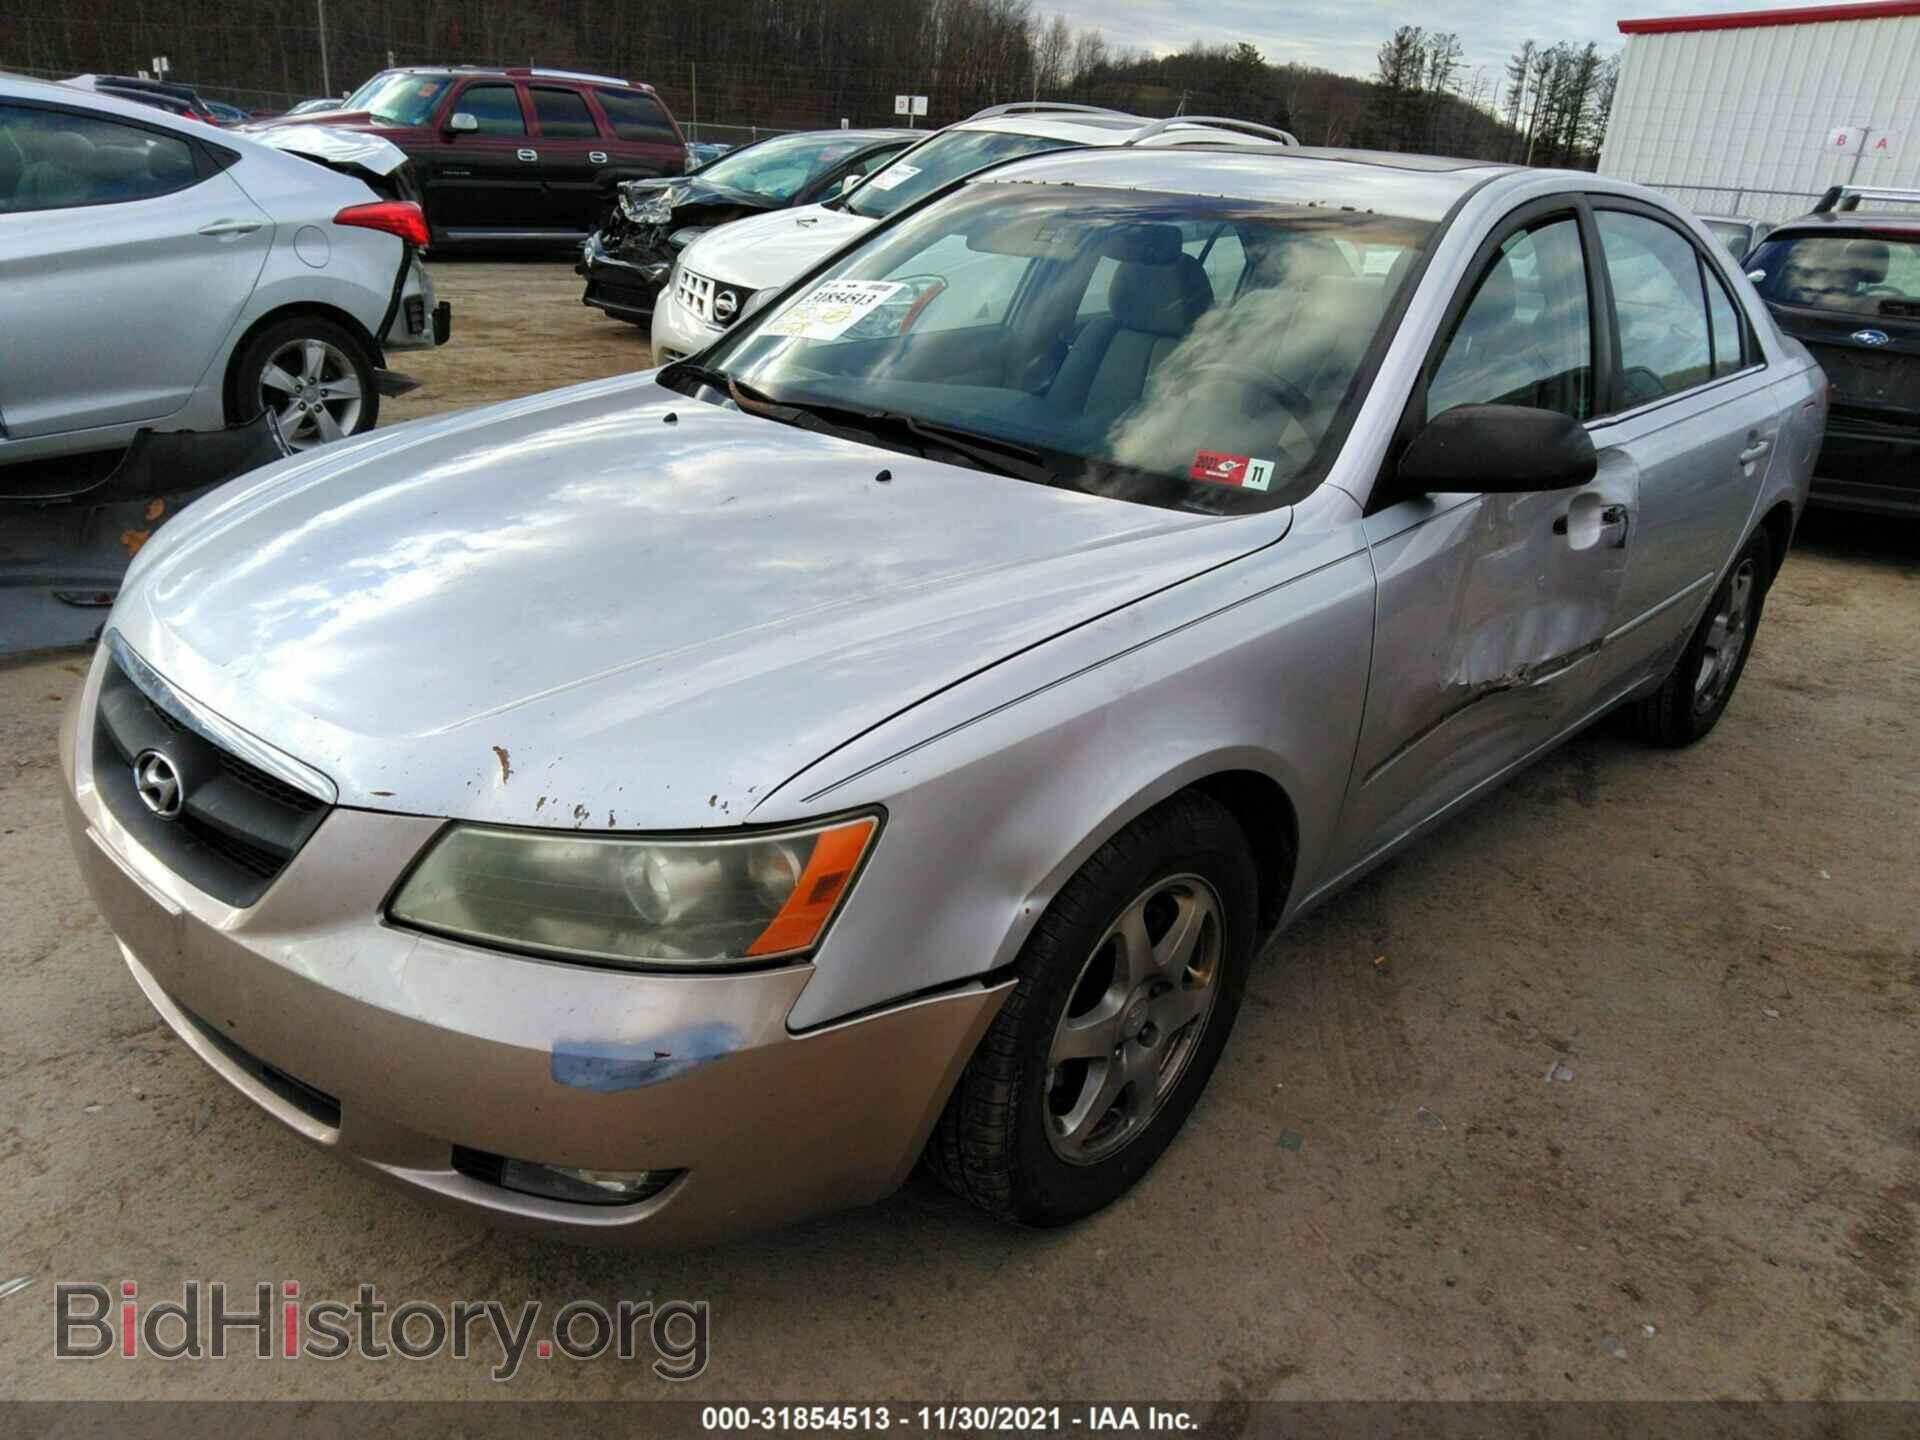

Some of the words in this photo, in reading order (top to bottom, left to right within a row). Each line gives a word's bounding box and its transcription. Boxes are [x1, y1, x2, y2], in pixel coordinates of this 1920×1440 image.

[1836, 134, 1847, 146] B
[1875, 137, 1888, 149] A
[807, 291, 877, 306] 31854513
[1251, 465, 1265, 483] 11
